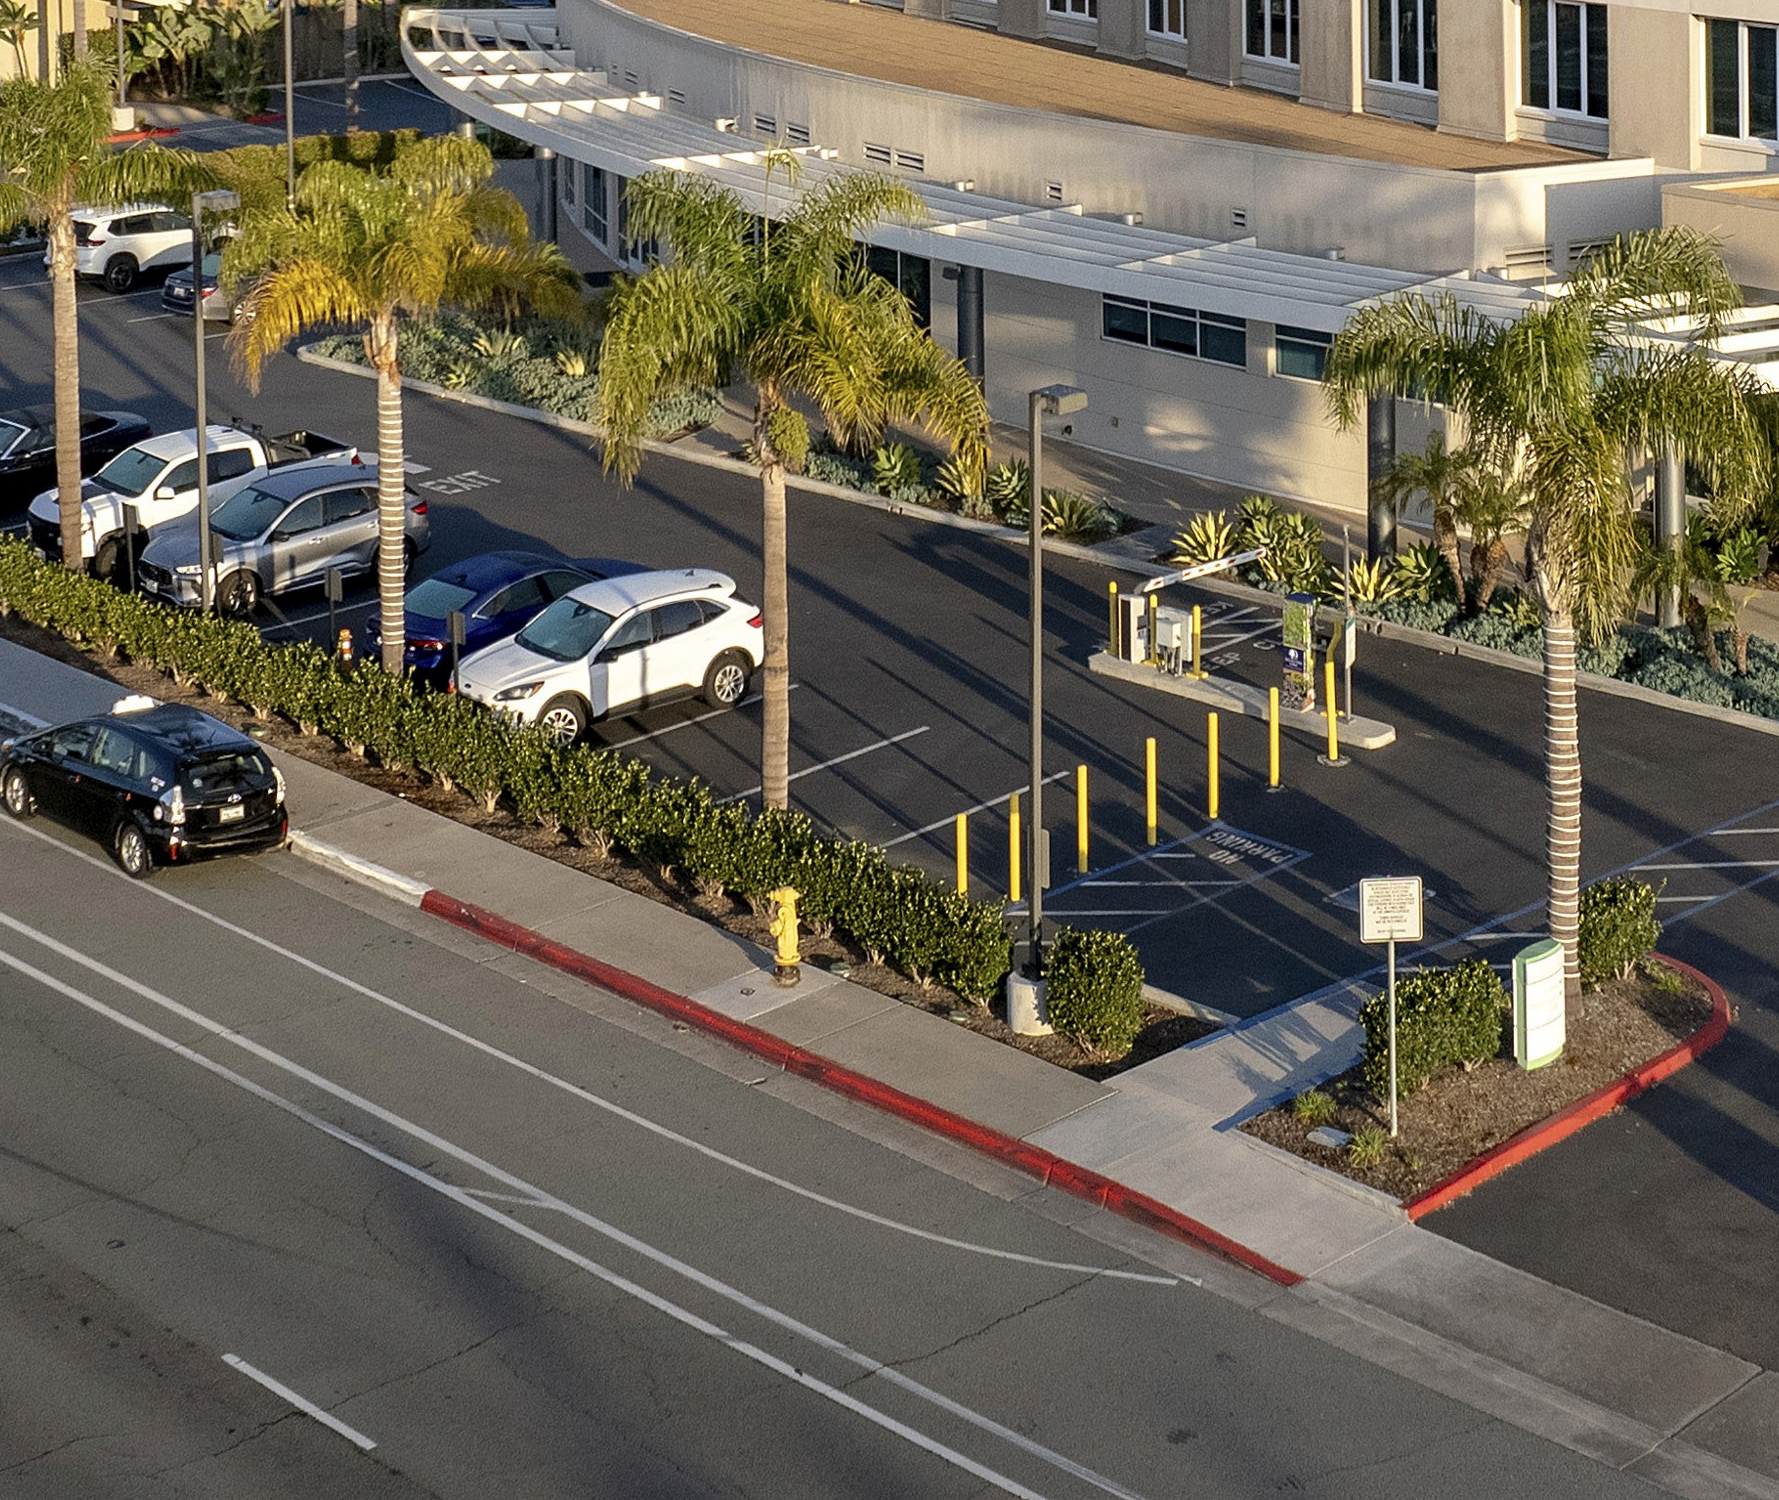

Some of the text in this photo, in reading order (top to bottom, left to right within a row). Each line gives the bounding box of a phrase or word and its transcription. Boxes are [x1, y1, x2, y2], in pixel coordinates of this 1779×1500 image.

[417, 470, 501, 495] EXIT
[1205, 831, 1294, 864] PARKING
[1208, 849, 1245, 865] NO
